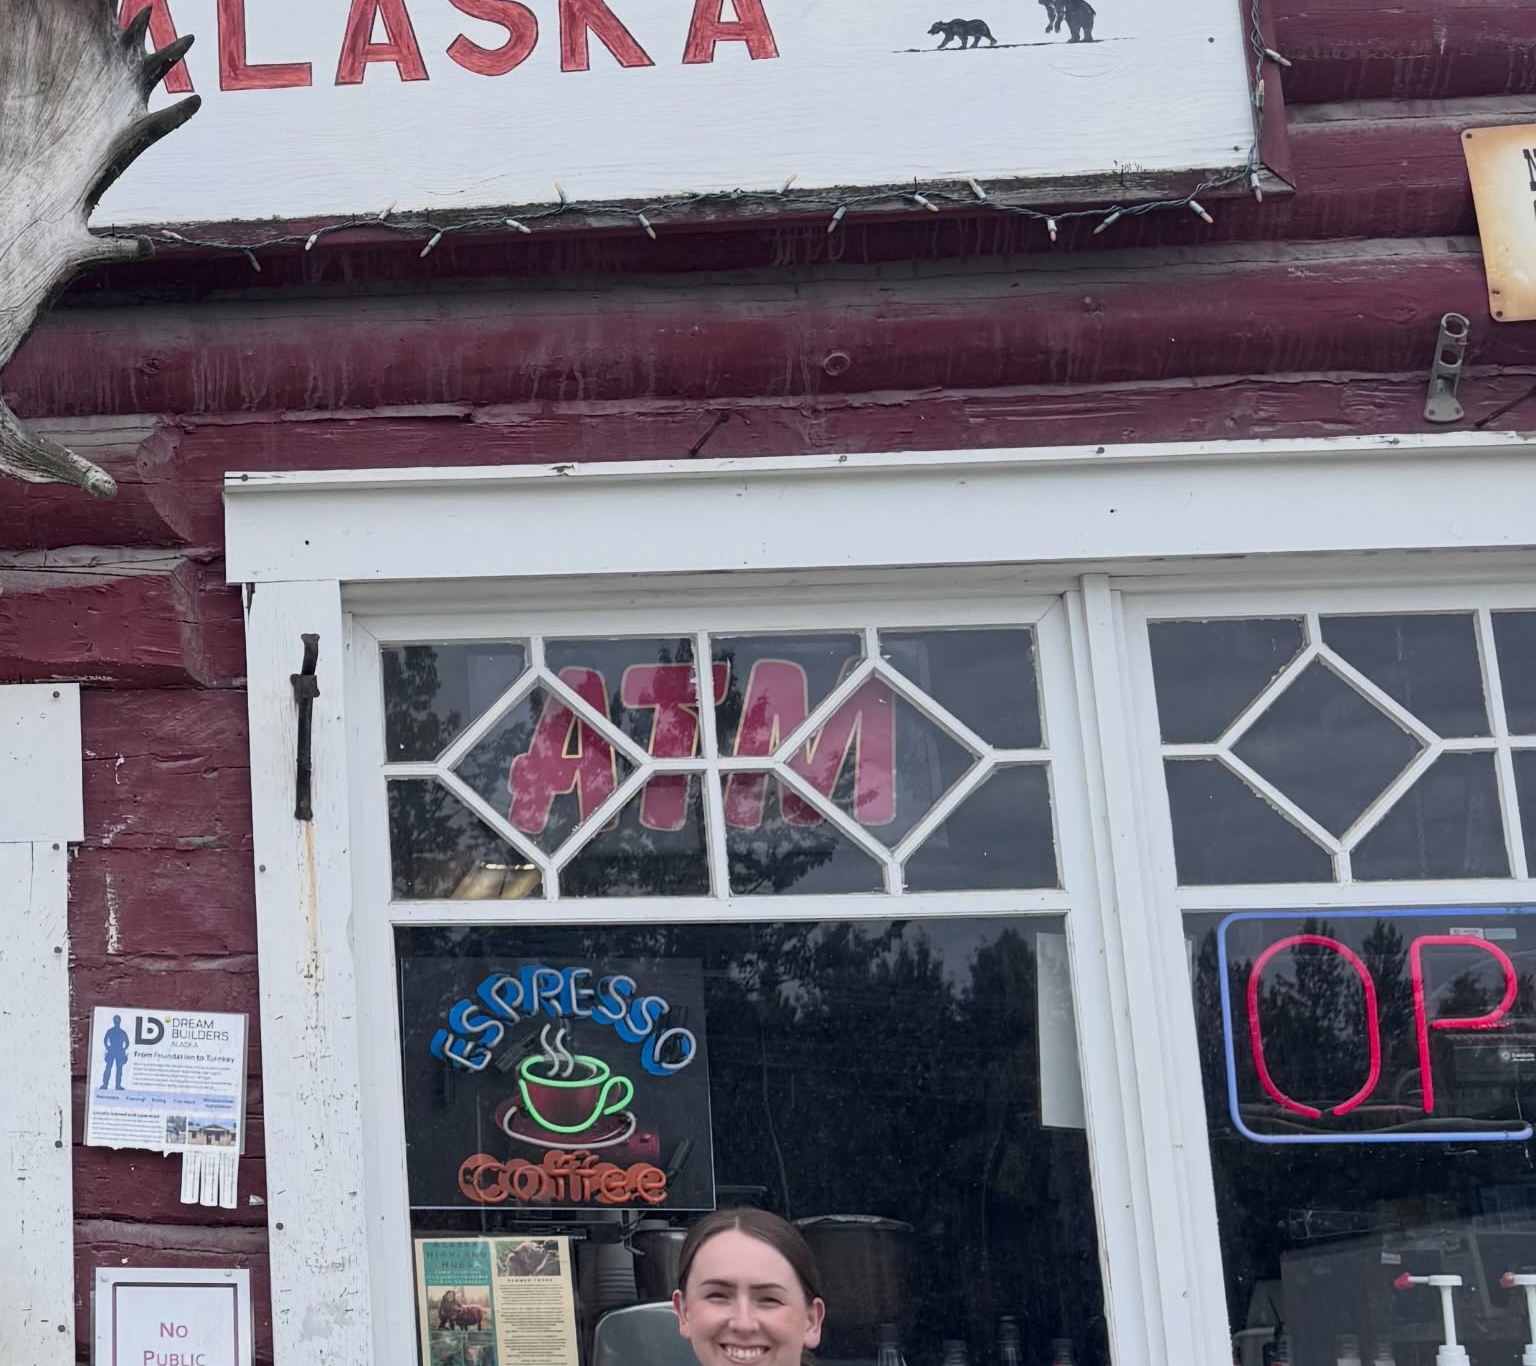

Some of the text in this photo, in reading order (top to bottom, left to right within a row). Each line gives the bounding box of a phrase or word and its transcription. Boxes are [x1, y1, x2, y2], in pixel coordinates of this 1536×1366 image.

[508, 657, 897, 835] ATM
[171, 1017, 214, 1029] DREAM
[171, 1028, 230, 1042] BUILDERS
[430, 965, 697, 1076] ESPRESSO
[458, 1150, 668, 1203] Coffee
